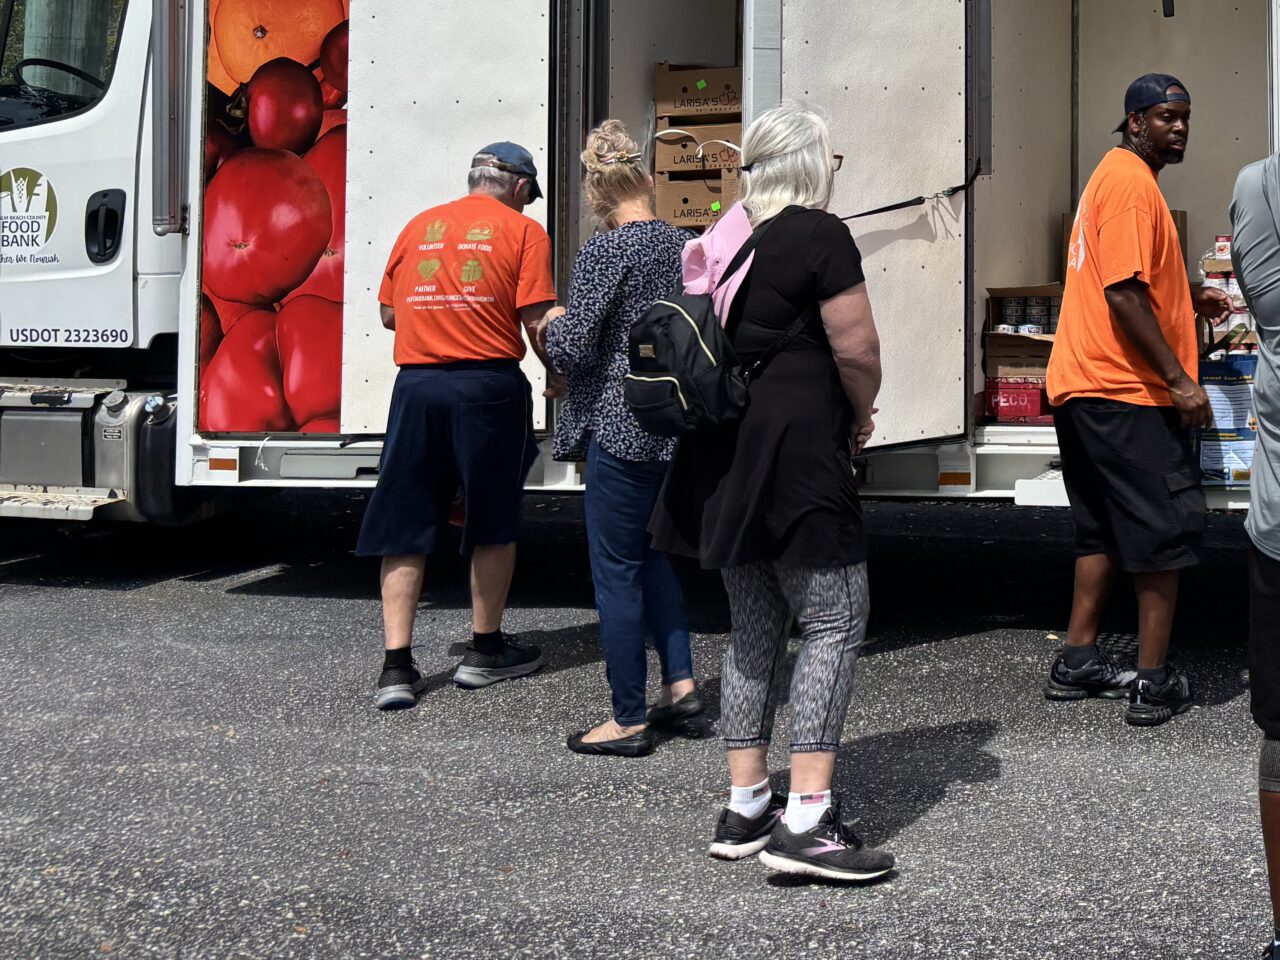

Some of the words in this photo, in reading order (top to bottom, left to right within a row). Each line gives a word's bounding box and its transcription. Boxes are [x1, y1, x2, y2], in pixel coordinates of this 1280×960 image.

[674, 97, 718, 109] LARISA'S
[2, 220, 41, 233] FOOD
[2, 234, 40, 247] BANK
[10, 329, 60, 343] USDOT
[64, 329, 129, 343] 2323690
